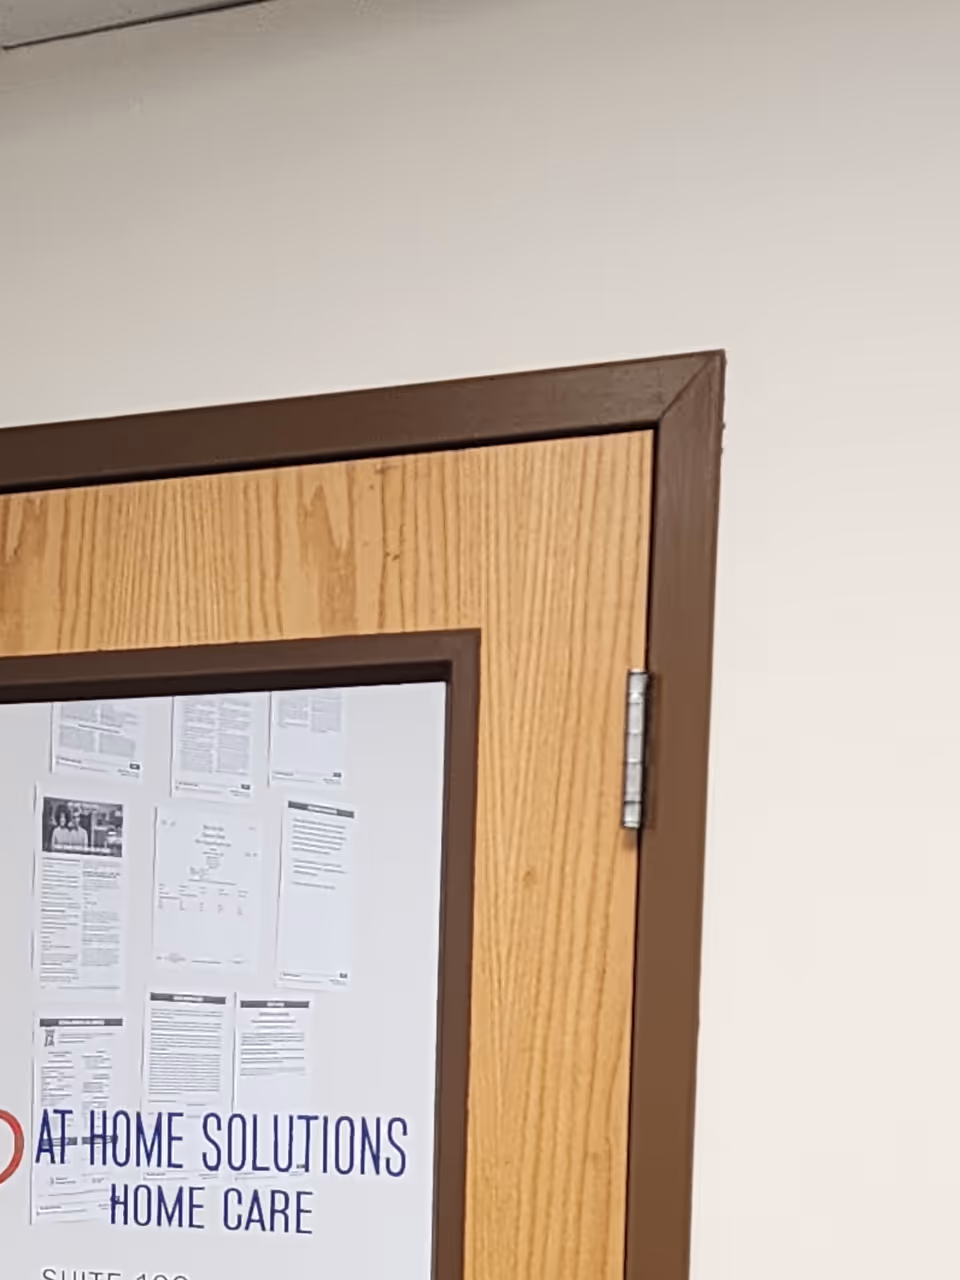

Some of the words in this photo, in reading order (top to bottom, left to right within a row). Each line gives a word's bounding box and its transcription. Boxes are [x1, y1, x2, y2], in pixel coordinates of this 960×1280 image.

[35, 1108, 73, 1164] AT
[89, 1109, 184, 1169] HOME
[202, 1112, 408, 1177] SOLUTIONS
[110, 1183, 206, 1229] HOME
[223, 1187, 313, 1234] CARE
